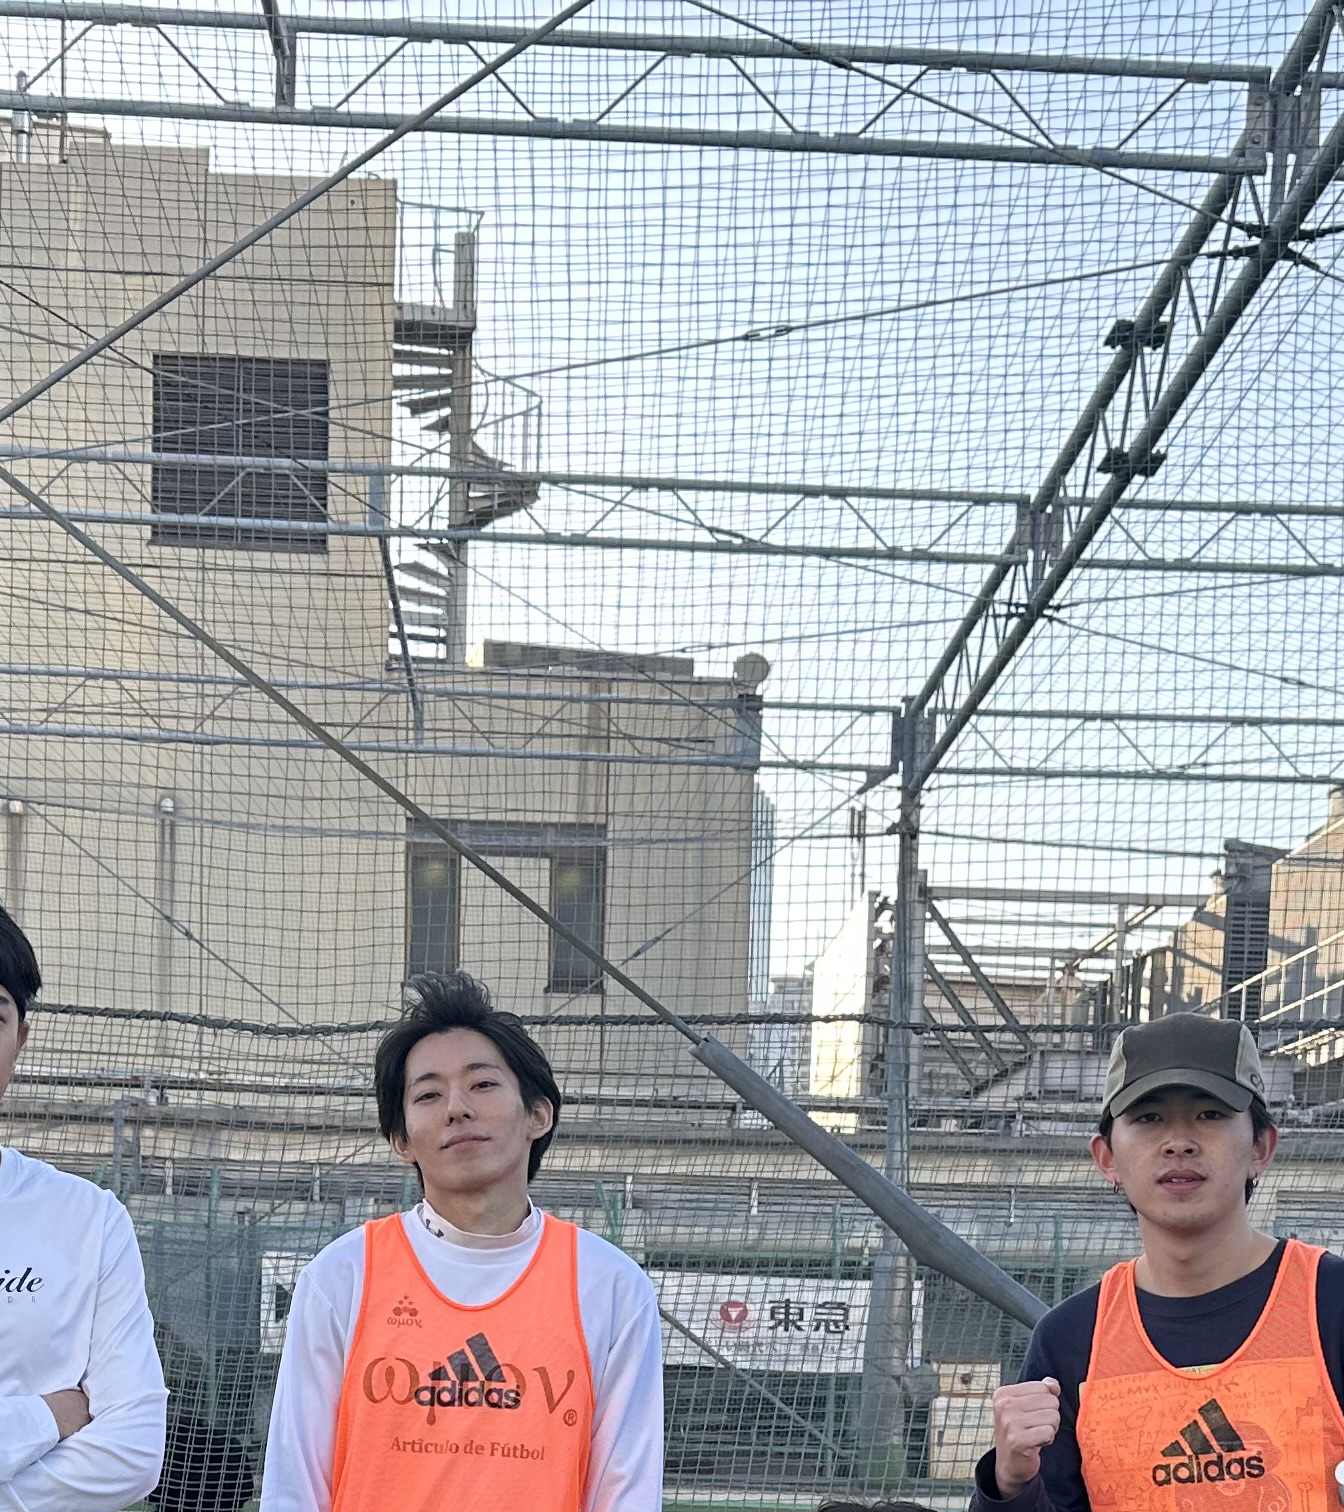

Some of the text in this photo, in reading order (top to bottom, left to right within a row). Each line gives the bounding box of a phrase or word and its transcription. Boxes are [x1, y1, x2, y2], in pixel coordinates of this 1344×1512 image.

[768, 1298, 851, 1334] 東急
[414, 1380, 521, 1410] adidas
[463, 1440, 485, 1456] de
[1152, 1452, 1265, 1487] adidas
